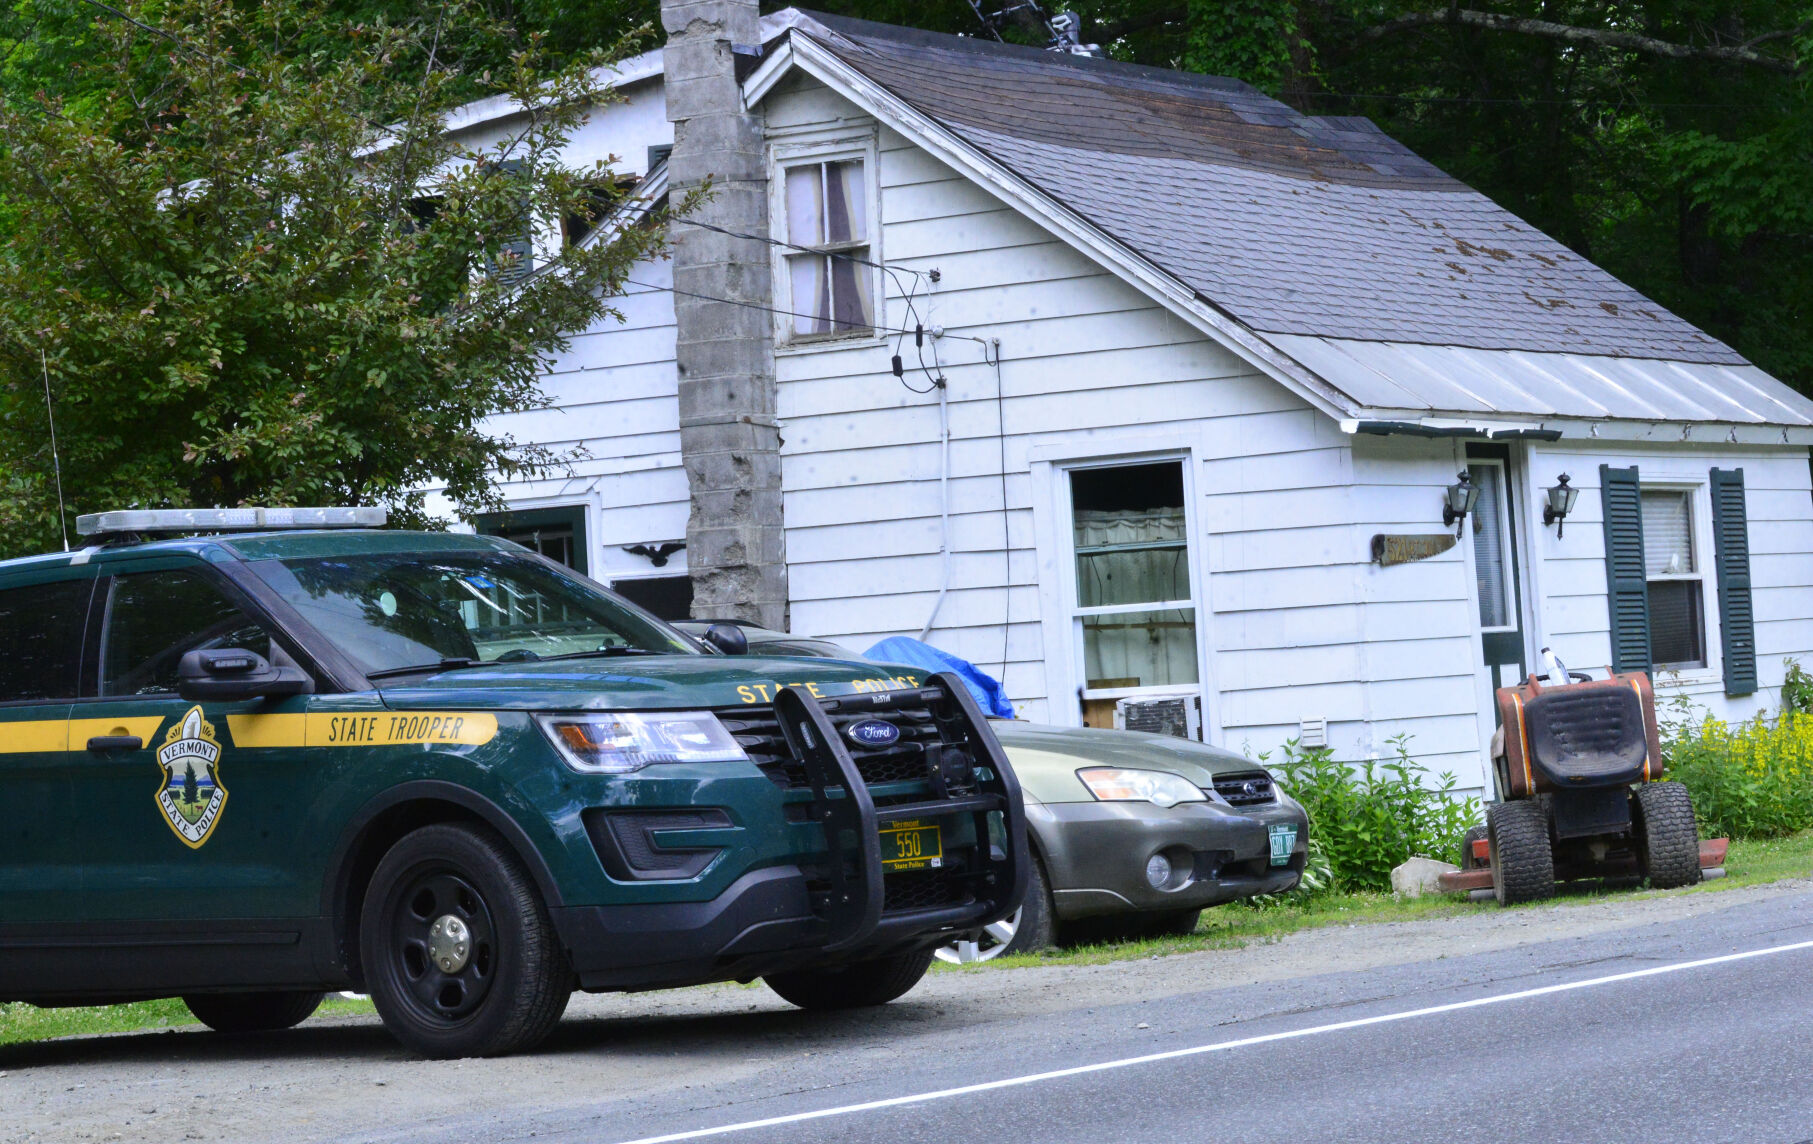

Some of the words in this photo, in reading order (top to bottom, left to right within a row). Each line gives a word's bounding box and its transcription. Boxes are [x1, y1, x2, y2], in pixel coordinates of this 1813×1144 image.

[737, 682, 827, 703] STE
[329, 716, 378, 742] STATE
[387, 716, 464, 741] TROOPER
[864, 725, 892, 739] Ford
[163, 741, 216, 760] VERMONT
[161, 792, 190, 836] STATE
[194, 791, 222, 836] POLICE
[896, 831, 921, 858] 550
